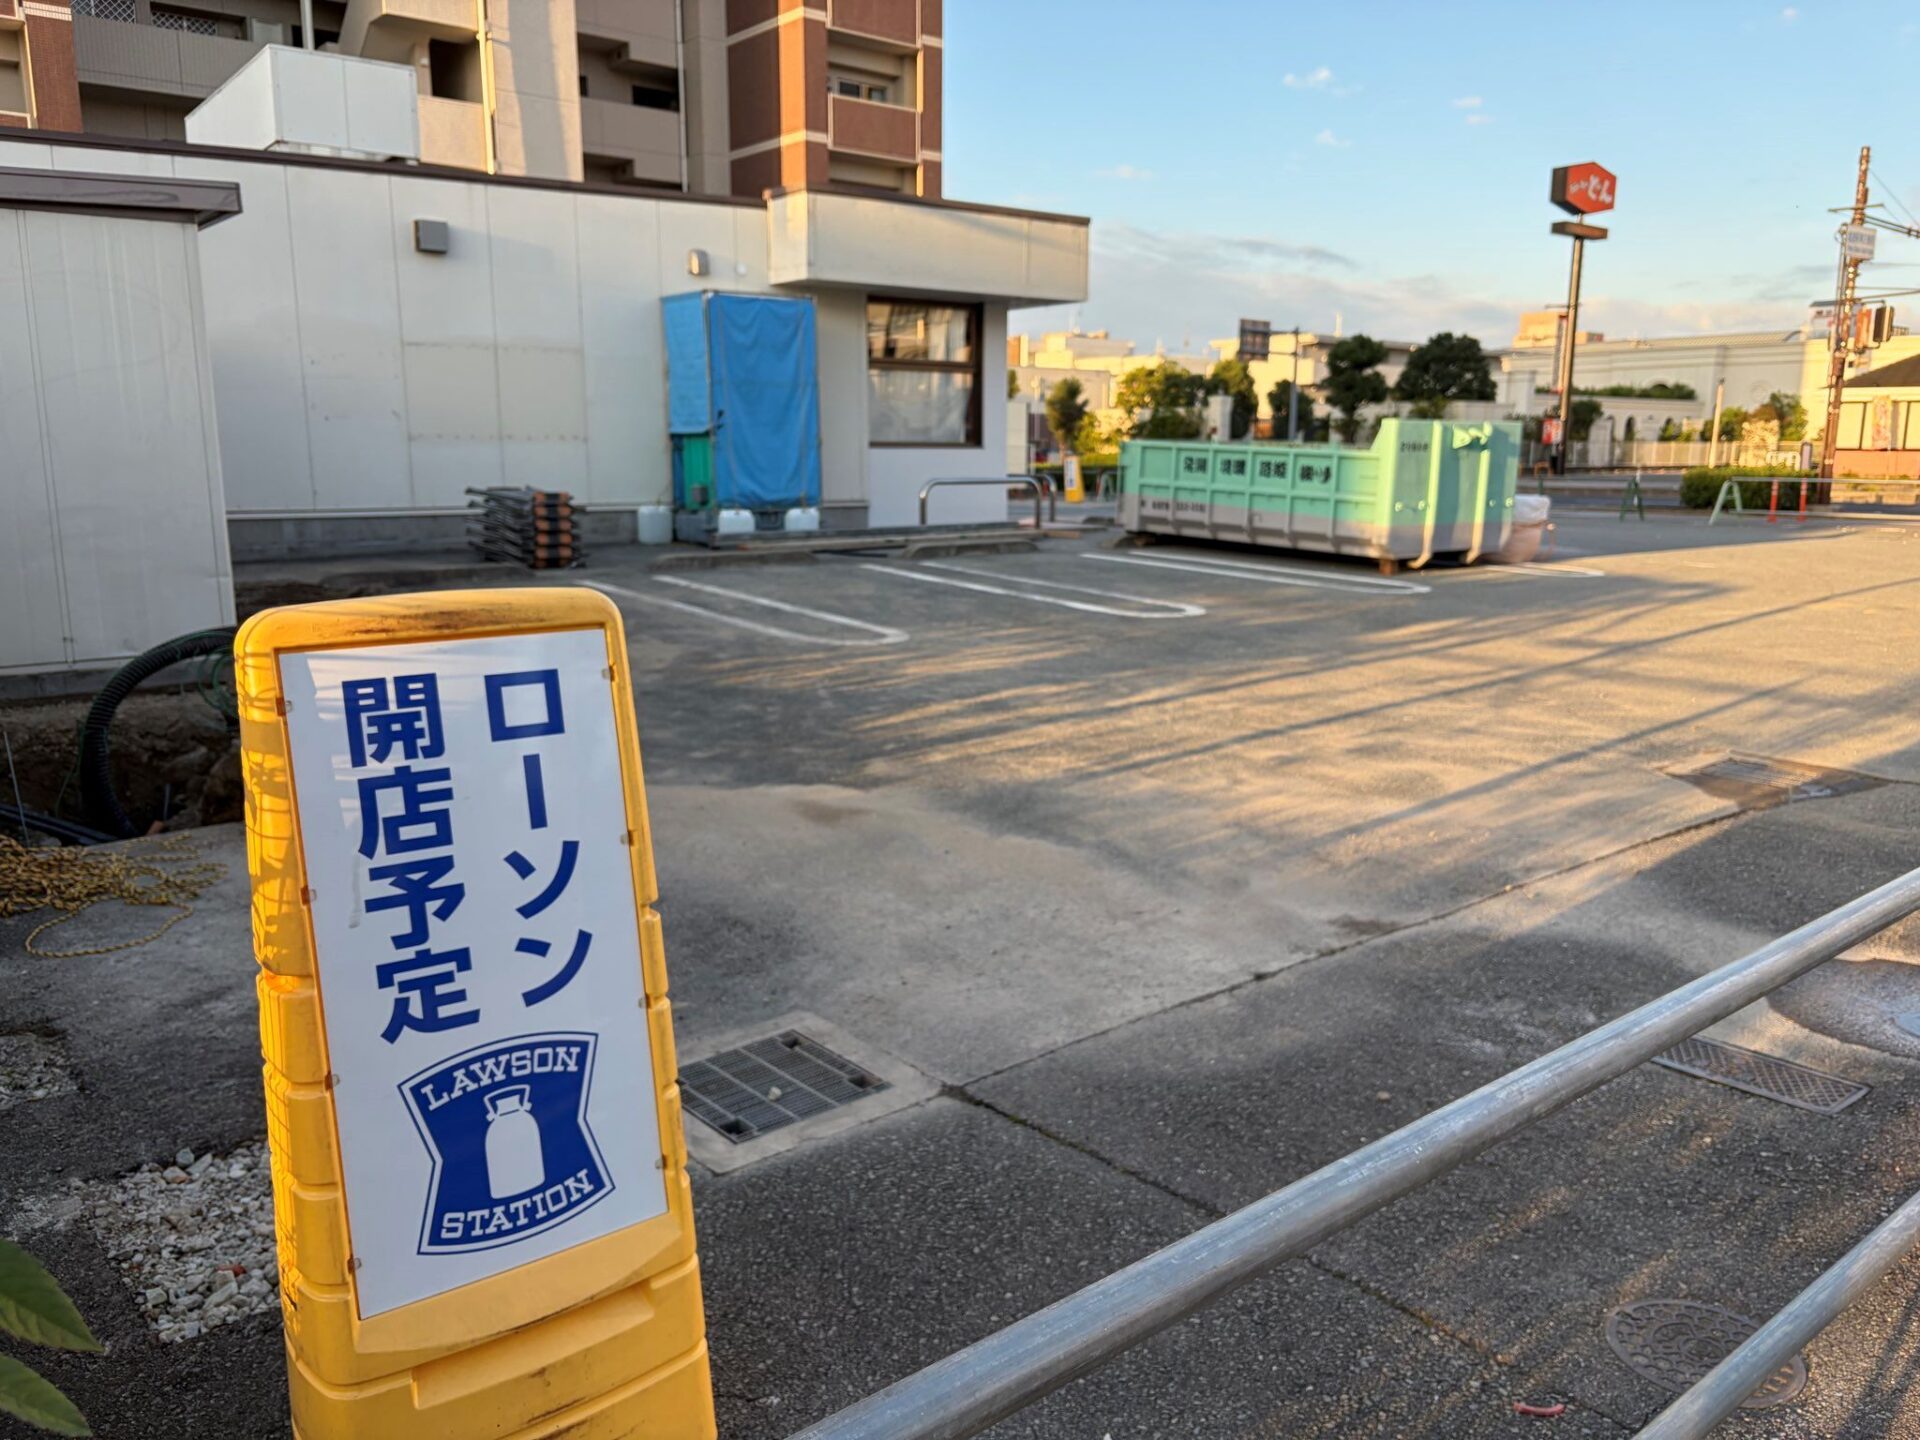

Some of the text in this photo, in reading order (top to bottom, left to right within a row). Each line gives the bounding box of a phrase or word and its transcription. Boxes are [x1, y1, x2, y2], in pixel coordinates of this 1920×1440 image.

[342, 673, 481, 1044] 開店予定
[485, 668, 594, 1006] ローソン
[420, 1046, 581, 1111] LAWSON
[440, 1168, 595, 1239] STATION
